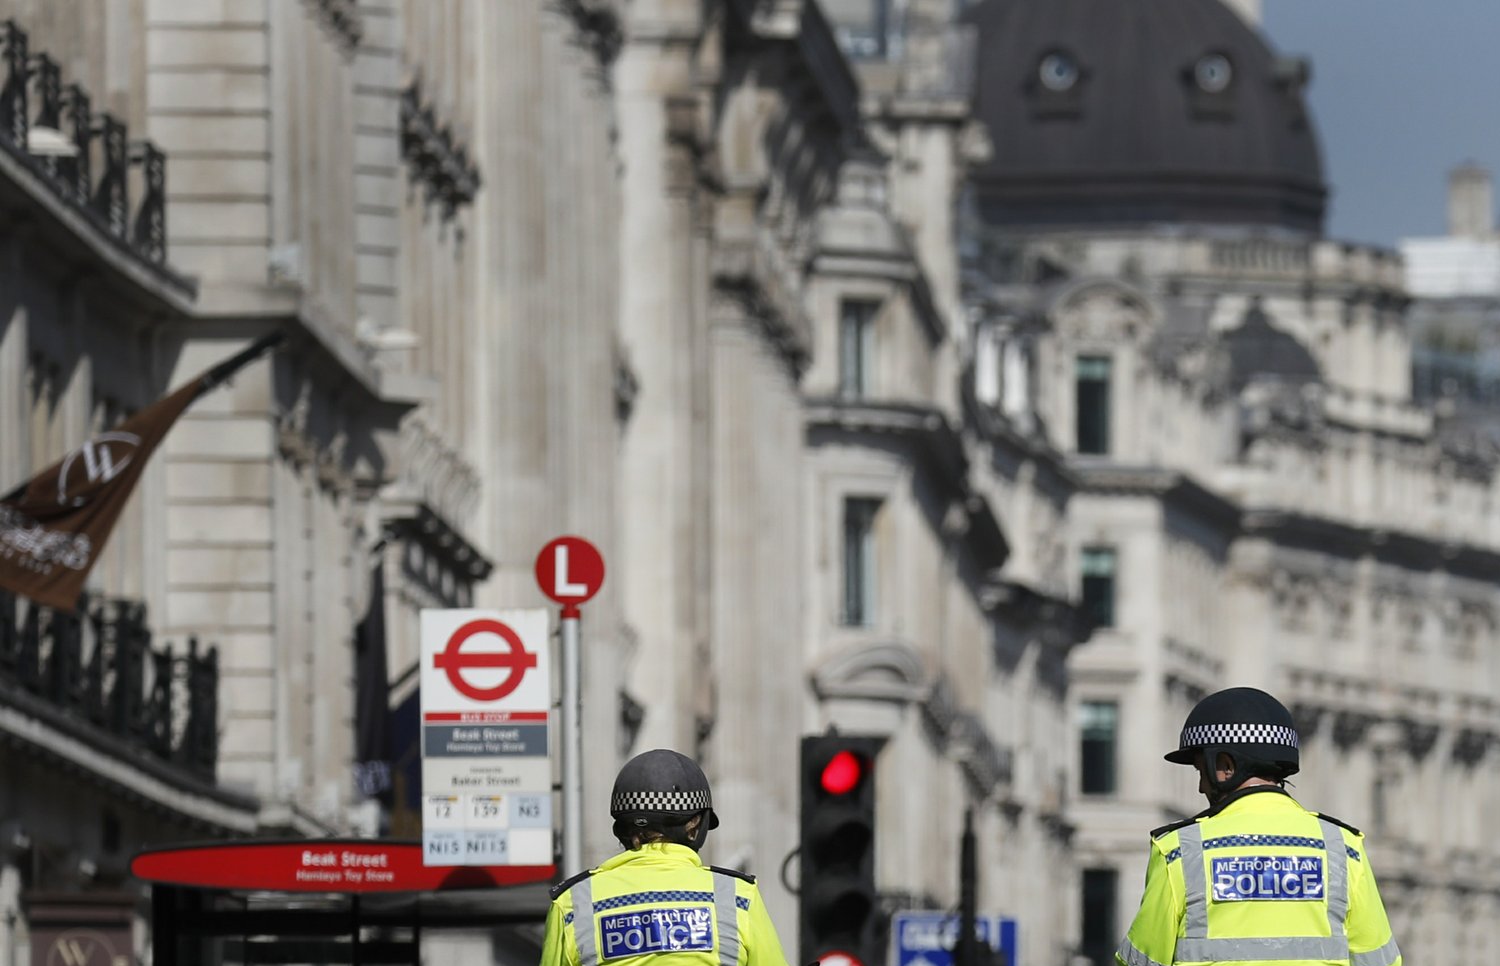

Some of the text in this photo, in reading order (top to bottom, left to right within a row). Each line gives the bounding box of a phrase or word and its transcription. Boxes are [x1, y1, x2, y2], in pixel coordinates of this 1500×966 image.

[554, 544, 588, 597] L
[452, 728, 519, 741] Beak Street
[485, 742, 499, 753] Toy
[501, 742, 526, 752] Store
[451, 776, 520, 786] Baker Street
[436, 806, 451, 818] 12
[474, 806, 498, 818] 139
[518, 806, 540, 818] N3
[302, 850, 388, 867] Beak Street
[1216, 859, 1318, 872] METROPOLITAN
[344, 870, 363, 883] Toy
[365, 870, 395, 882] Store
[1217, 873, 1319, 895] POLICE
[605, 909, 709, 930] METROPOLITAN
[606, 924, 708, 954] POLICE
